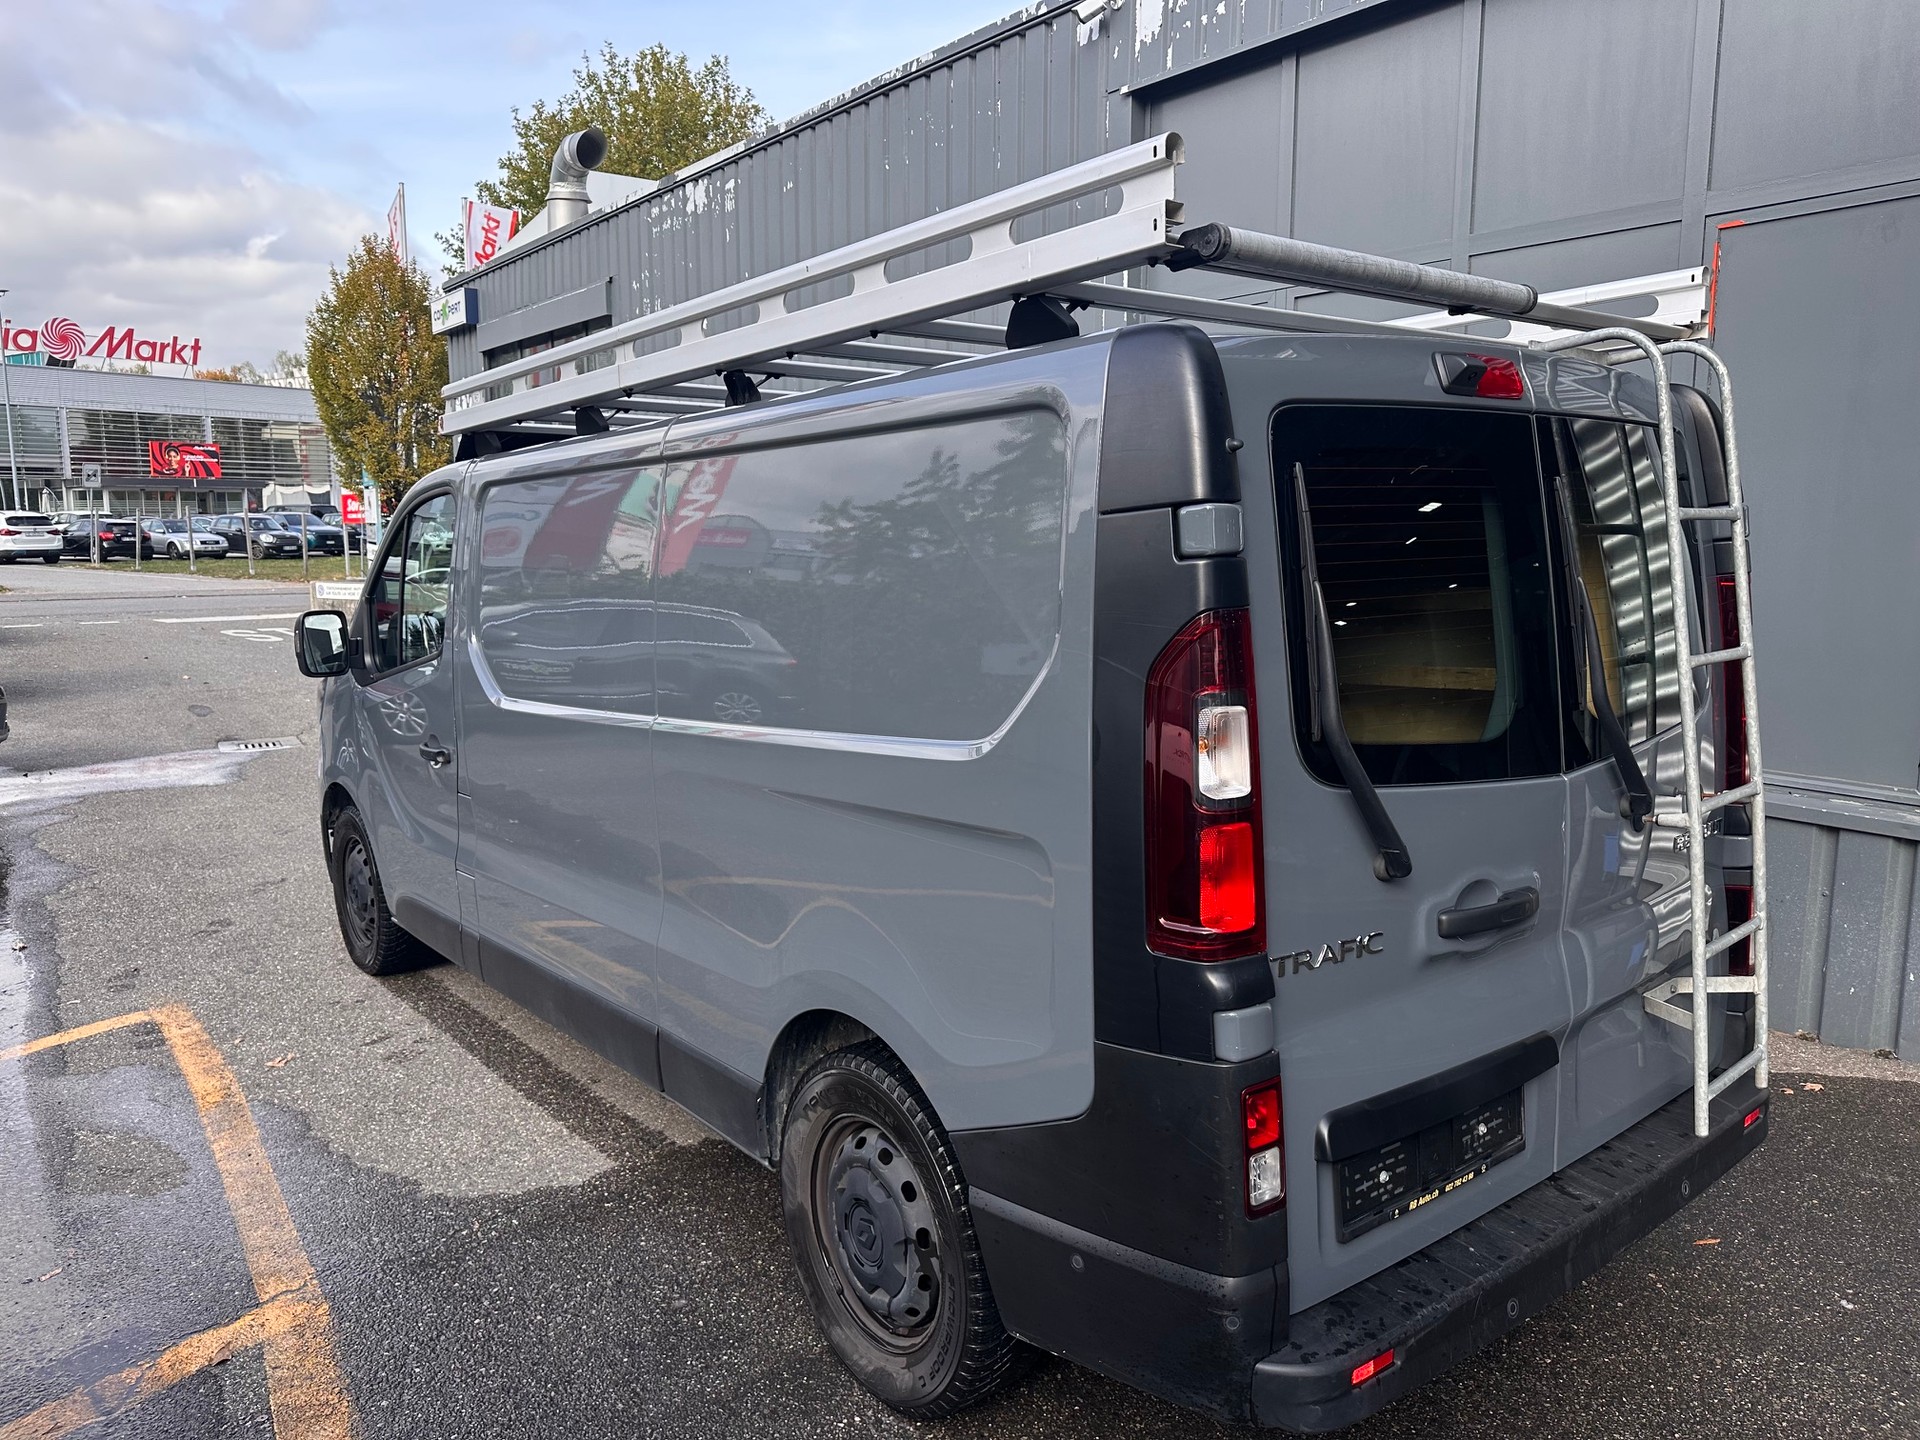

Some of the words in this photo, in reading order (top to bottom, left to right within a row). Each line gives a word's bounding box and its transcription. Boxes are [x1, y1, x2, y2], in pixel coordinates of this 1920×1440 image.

[473, 211, 501, 266] Markt
[85, 326, 201, 365] Markt
[219, 627, 295, 642] ST
[1269, 930, 1384, 978] TRAFIC
